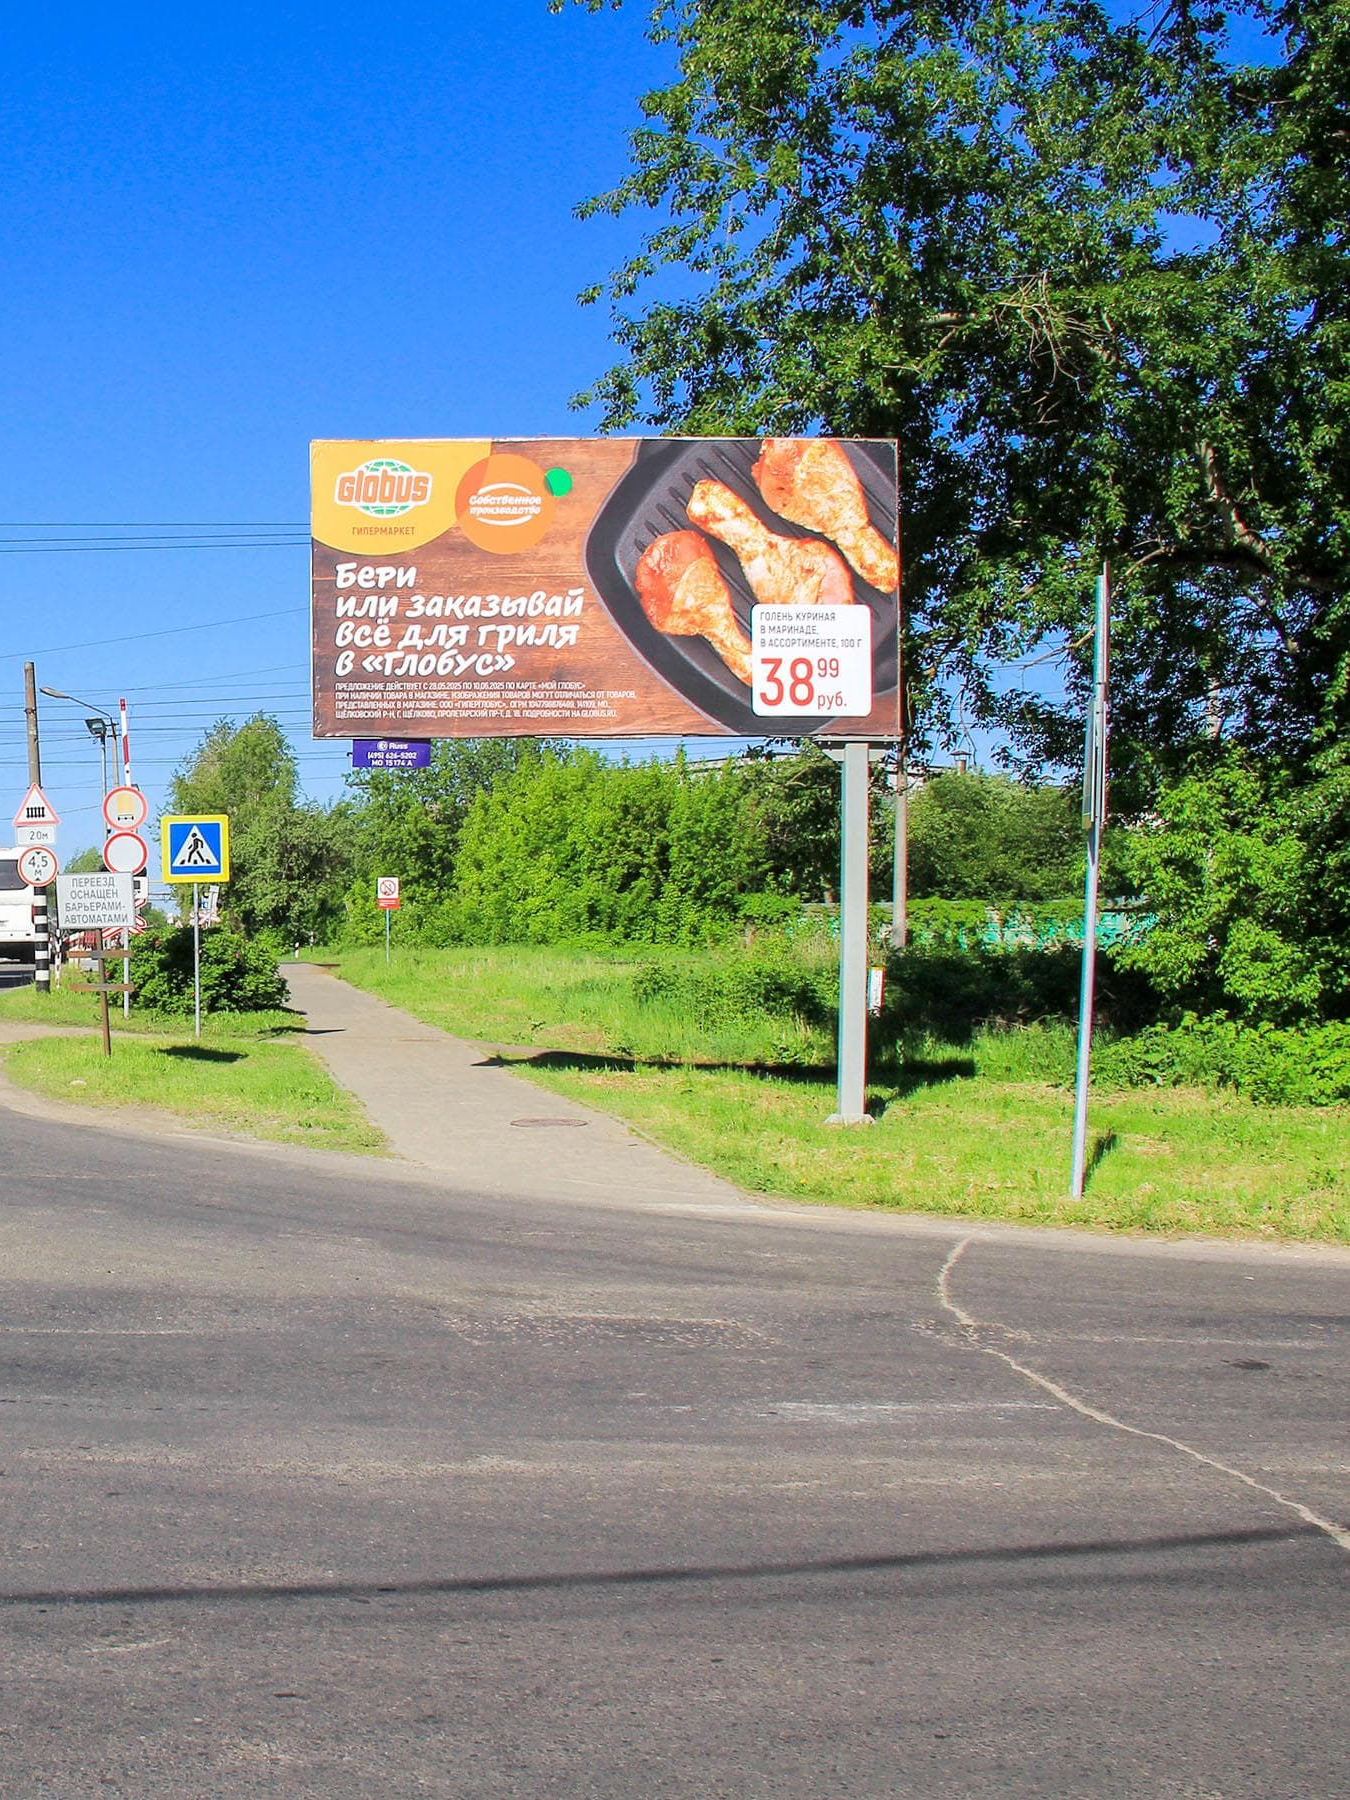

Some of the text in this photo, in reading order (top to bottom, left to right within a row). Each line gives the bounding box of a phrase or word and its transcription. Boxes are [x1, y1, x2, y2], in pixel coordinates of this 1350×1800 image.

[468, 494, 542, 506] Собственное
[468, 505, 541, 515] производство
[351, 526, 416, 536] ГИПЕРМАРКЕТ
[334, 562, 417, 590] Бери
[334, 587, 585, 620] или заказывай
[759, 612, 836, 621] ГОЛЕНЬ КУРИНАЯ
[334, 618, 580, 653] всё для гриля
[760, 625, 819, 635] В МАРИНАДЕ,
[760, 638, 766, 648] В
[768, 638, 839, 649] АССОРТИМЕНТЕ,
[840, 639, 855, 648] 100
[334, 649, 516, 678] в «Глобус»
[335, 682, 385, 691] ПРЕДЛОЖЕНИЕ
[386, 680, 422, 691] ДЕЙСТВУЕТ
[463, 682, 472, 690] ПО
[506, 682, 515, 690] ПО
[516, 682, 537, 690] КАРТЕ
[760, 657, 840, 707] 38 99
[335, 691, 349, 700] ПРИ
[350, 691, 382, 700] НАЛИЧИИ
[383, 691, 407, 700] ТОВАРА
[408, 691, 414, 699] В
[451, 691, 501, 699] ИЗОБРАЖЕНИЯ
[501, 691, 530, 699] ТОВАРОВ
[531, 691, 553, 699] МОГУТ
[554, 690, 595, 699] ОТЛИЧАТЬСЯ
[596, 690, 606, 698] ОТ
[817, 690, 848, 710] руб.
[335, 701, 395, 710] ПРЕДСТАВЛЕННЫХ
[396, 701, 402, 709] В
[439, 700, 453, 708] ООО
[335, 709, 381, 719] ЩЁЛКОВСКИЙ
[438, 708, 488, 718] ПРОЛЕТАРСКИЙ
[522, 709, 571, 718] ПОДРОБНОСТИ
[571, 709, 581, 717] НА
[389, 742, 409, 750] Russ
[28, 855, 49, 868] 4,5
[71, 877, 115, 888] ПЕРЕЕЗД
[70, 889, 118, 900] ОСНАЩЕН
[65, 901, 126, 912] БАРЬЕРАМИ-
[64, 914, 128, 925] АВТОМАТАМИ
